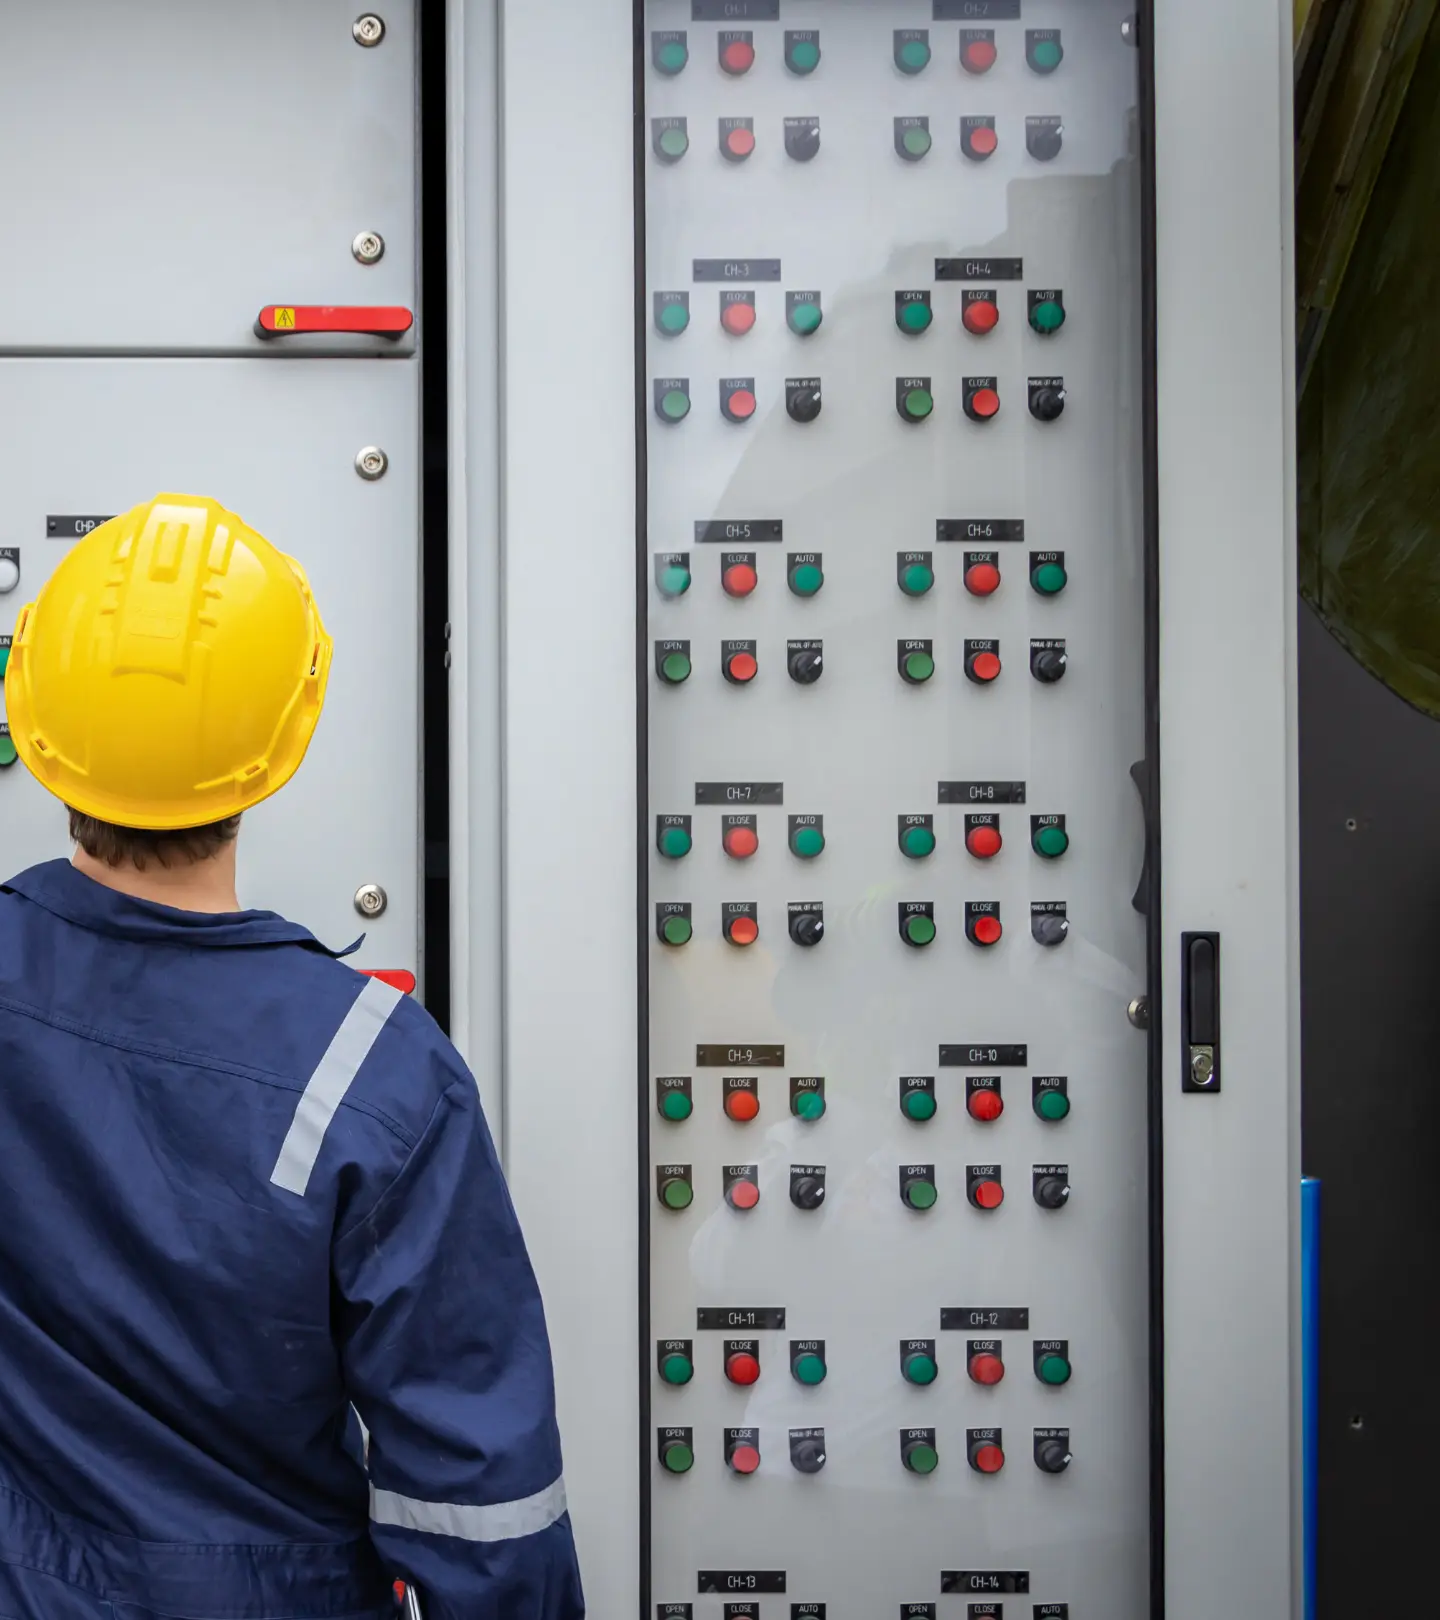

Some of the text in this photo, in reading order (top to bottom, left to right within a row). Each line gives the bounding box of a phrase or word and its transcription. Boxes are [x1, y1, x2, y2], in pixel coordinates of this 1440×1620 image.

[723, 3, 749, 15] CH-1
[963, 3, 990, 15] CH-2
[791, 32, 813, 41] AUTO
[1033, 31, 1054, 40] AUTO
[723, 263, 750, 277] CH-3
[965, 262, 992, 276] CH-4
[726, 292, 748, 301] CLOSE
[793, 292, 814, 302] AUTO
[903, 291, 924, 301] OPEN
[967, 291, 990, 301] CLOSE
[1035, 291, 1056, 300] AUTO
[662, 379, 682, 389] OPEN
[725, 379, 748, 389] CLOSE
[904, 378, 924, 388] OPEN
[968, 377, 991, 387] CLOSE
[725, 524, 751, 539] CH-5
[967, 523, 993, 538] CH-6
[727, 553, 749, 563] CLOSE
[794, 554, 816, 563] AUTO
[904, 552, 925, 562] OPEN
[970, 552, 992, 562] CLOSE
[1037, 552, 1058, 562] AUTO
[663, 641, 683, 651] OPEN
[727, 641, 750, 651] CLOSE
[905, 640, 925, 650] OPEN
[970, 640, 993, 650] CLOSE
[726, 785, 752, 801] CH-7
[969, 785, 995, 800] CH-8
[664, 815, 684, 825] OPEN
[728, 815, 751, 825] CLOSE
[795, 815, 816, 825] AUTO
[905, 815, 926, 825] OPEN
[970, 814, 993, 824] CLOSE
[1038, 815, 1059, 825] AUTO
[664, 903, 685, 913] OPEN
[728, 903, 751, 913] CLOSE
[906, 902, 926, 912] OPEN
[971, 902, 994, 912] CLOSE
[727, 1048, 753, 1062] CH-9
[968, 1048, 998, 1062] CH-10
[664, 1078, 684, 1088] OPEN
[728, 1077, 751, 1087] CLOSE
[797, 1077, 817, 1087] AUTO
[907, 1077, 927, 1087] OPEN
[972, 1077, 995, 1087] CLOSE
[1039, 1077, 1060, 1087] AUTO
[664, 1165, 685, 1175] OPEN
[728, 1165, 751, 1175] CLOSE
[907, 1165, 927, 1175] OPEN
[972, 1165, 995, 1175] CLOSE
[727, 1311, 756, 1326] CH-11
[969, 1311, 999, 1326] CH-12
[665, 1341, 685, 1351] OPEN
[730, 1340, 753, 1350] CLOSE
[797, 1341, 818, 1351] AUTO
[908, 1341, 928, 1351] OPEN
[973, 1340, 996, 1350] CLOSE
[1040, 1341, 1062, 1351] AUTO
[665, 1428, 685, 1438] OPEN
[730, 1428, 753, 1438] CLOSE
[908, 1429, 928, 1439] OPEN
[973, 1429, 996, 1439] CLOSE
[727, 1575, 757, 1590] CH-13
[970, 1575, 1000, 1590] CH-14
[665, 1604, 685, 1614] OPEN
[730, 1603, 753, 1613] CLOSE
[798, 1603, 819, 1613] AUTO
[908, 1604, 928, 1614] OPEN
[973, 1604, 996, 1614] CLOSE
[1040, 1605, 1062, 1615] AUTO
